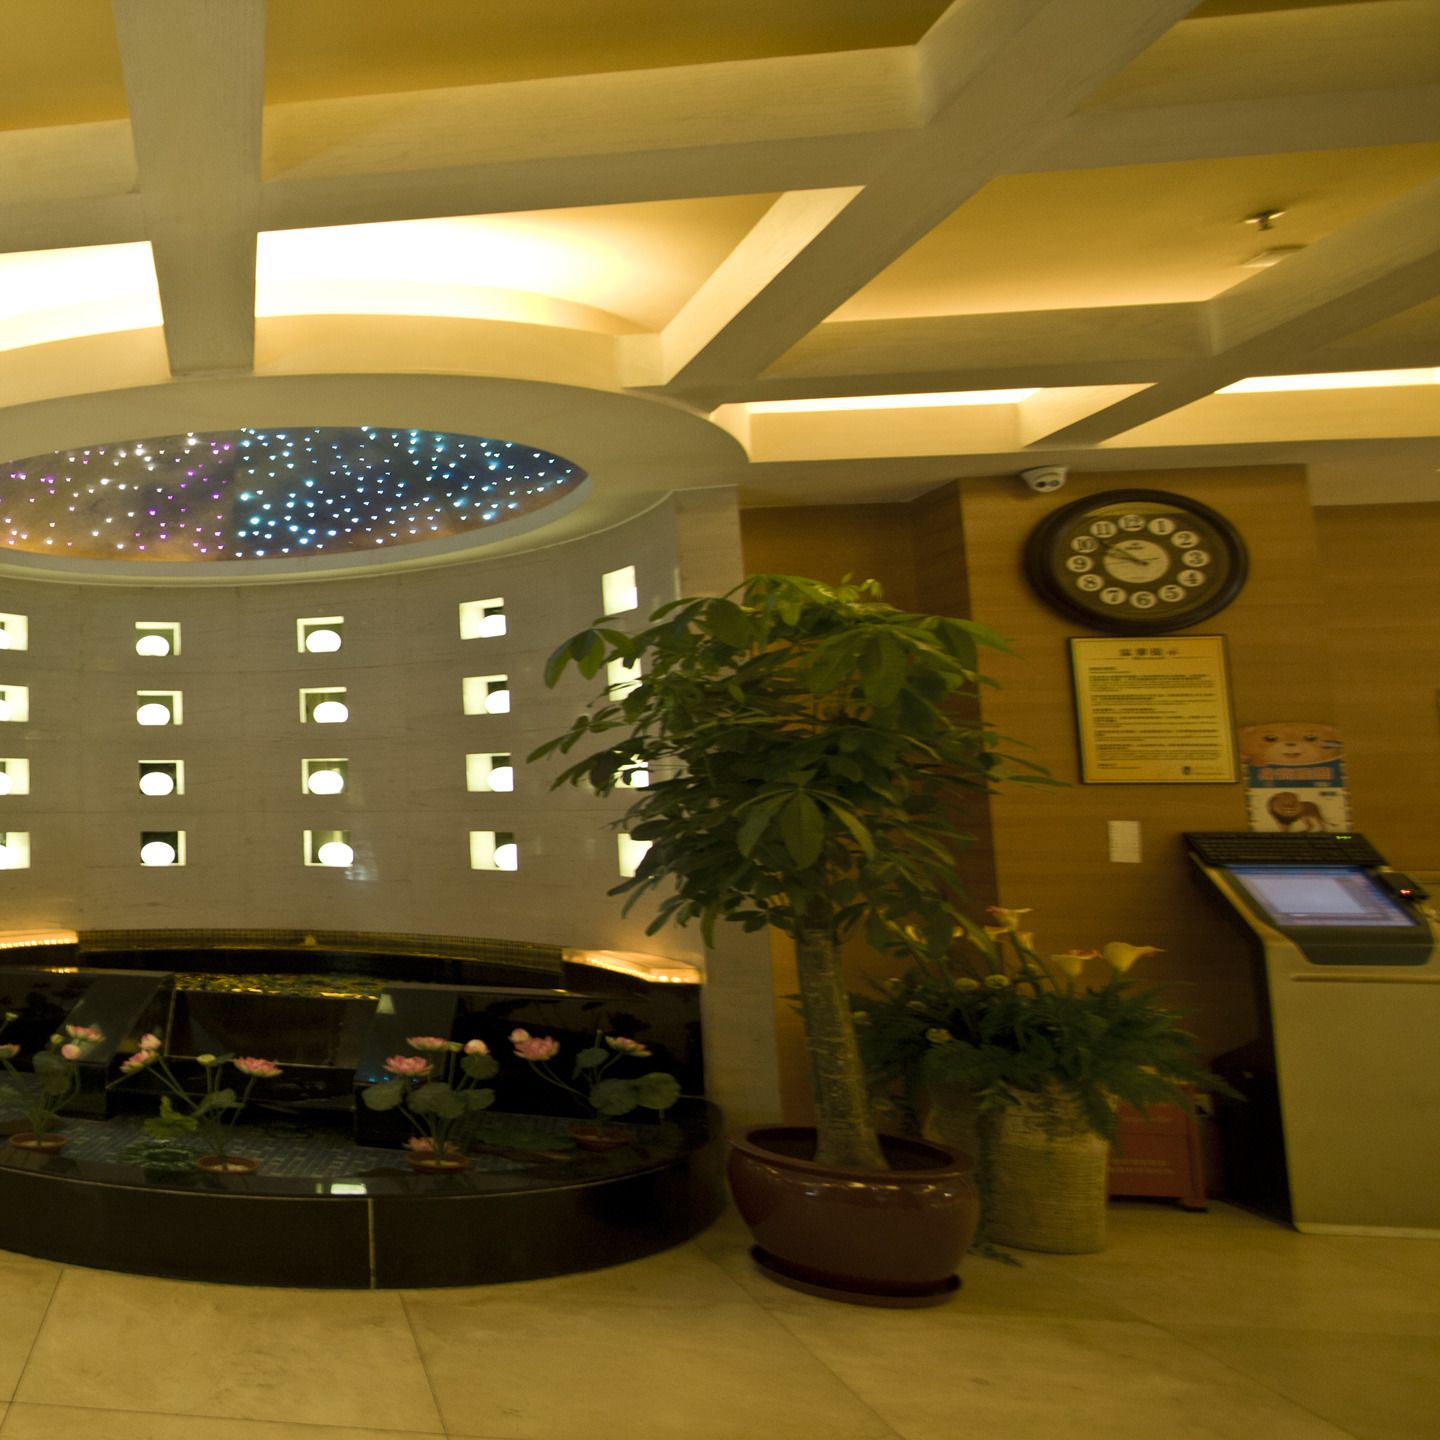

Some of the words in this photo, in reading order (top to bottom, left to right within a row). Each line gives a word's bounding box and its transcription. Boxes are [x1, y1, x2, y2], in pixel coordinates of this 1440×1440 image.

[1126, 515, 1140, 528] 12
[1096, 524, 1110, 535] 11
[1077, 538, 1093, 550] 10
[1177, 533, 1192, 545] 2
[1073, 557, 1085, 570] 9
[1189, 552, 1202, 564] 3
[1084, 576, 1096, 589] 8
[1183, 572, 1197, 584] 4
[1107, 590, 1118, 602] 7
[1137, 593, 1150, 606] 6
[1165, 587, 1178, 600] 5
